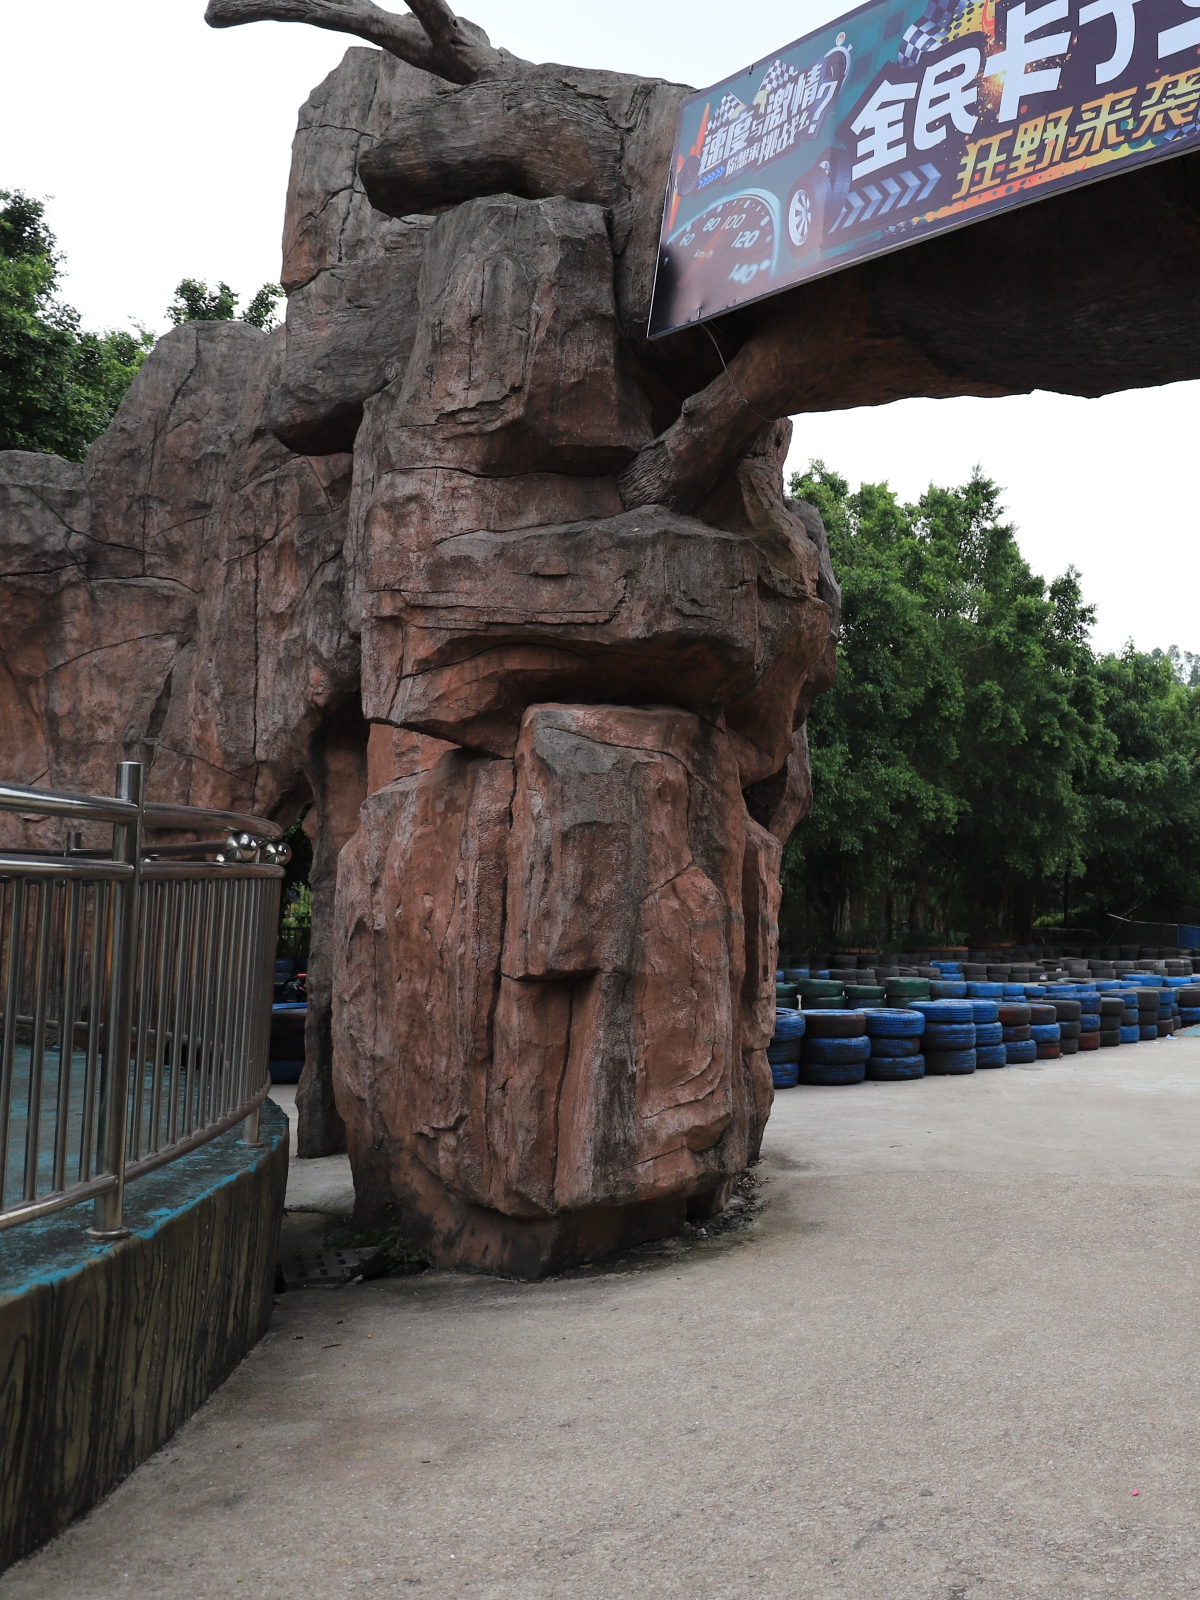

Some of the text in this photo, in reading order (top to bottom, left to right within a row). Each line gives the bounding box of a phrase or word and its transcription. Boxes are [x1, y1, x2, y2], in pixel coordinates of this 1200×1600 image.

[702, 217, 721, 232] 80
[721, 213, 746, 229] 100
[679, 233, 695, 246] 60
[731, 230, 760, 248] 120
[727, 263, 758, 284] 140
